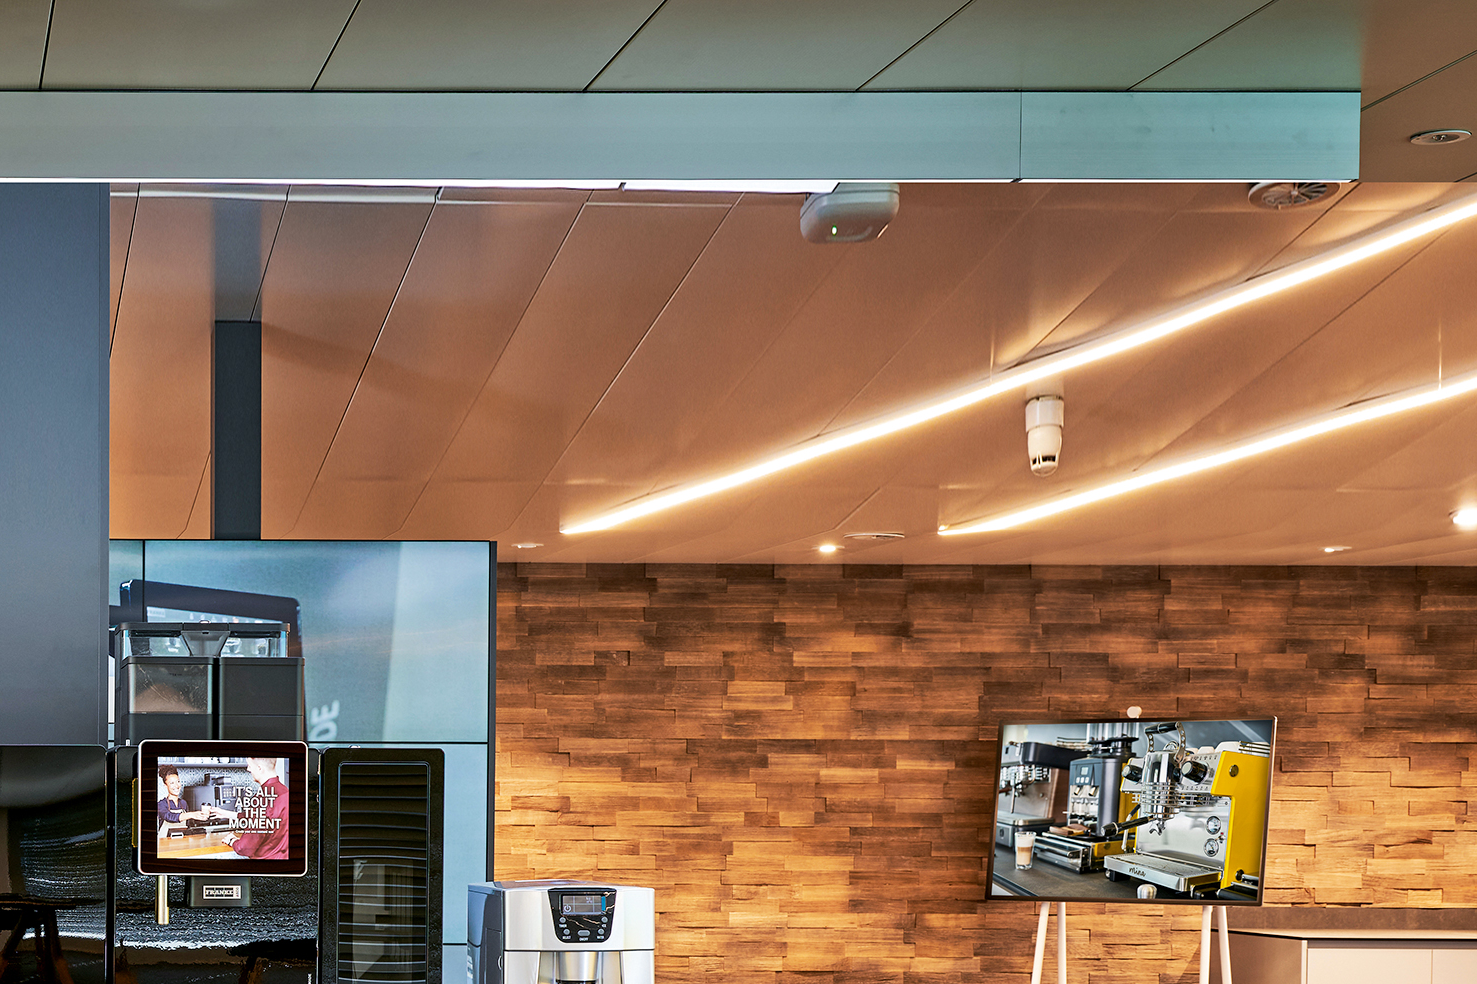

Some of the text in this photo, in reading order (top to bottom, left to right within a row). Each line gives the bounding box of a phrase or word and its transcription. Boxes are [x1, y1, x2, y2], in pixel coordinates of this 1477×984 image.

[232, 786, 278, 797] IT'S ALL
[235, 797, 276, 808] ABOUT
[243, 807, 267, 818] THE
[229, 818, 282, 829] MOMENT
